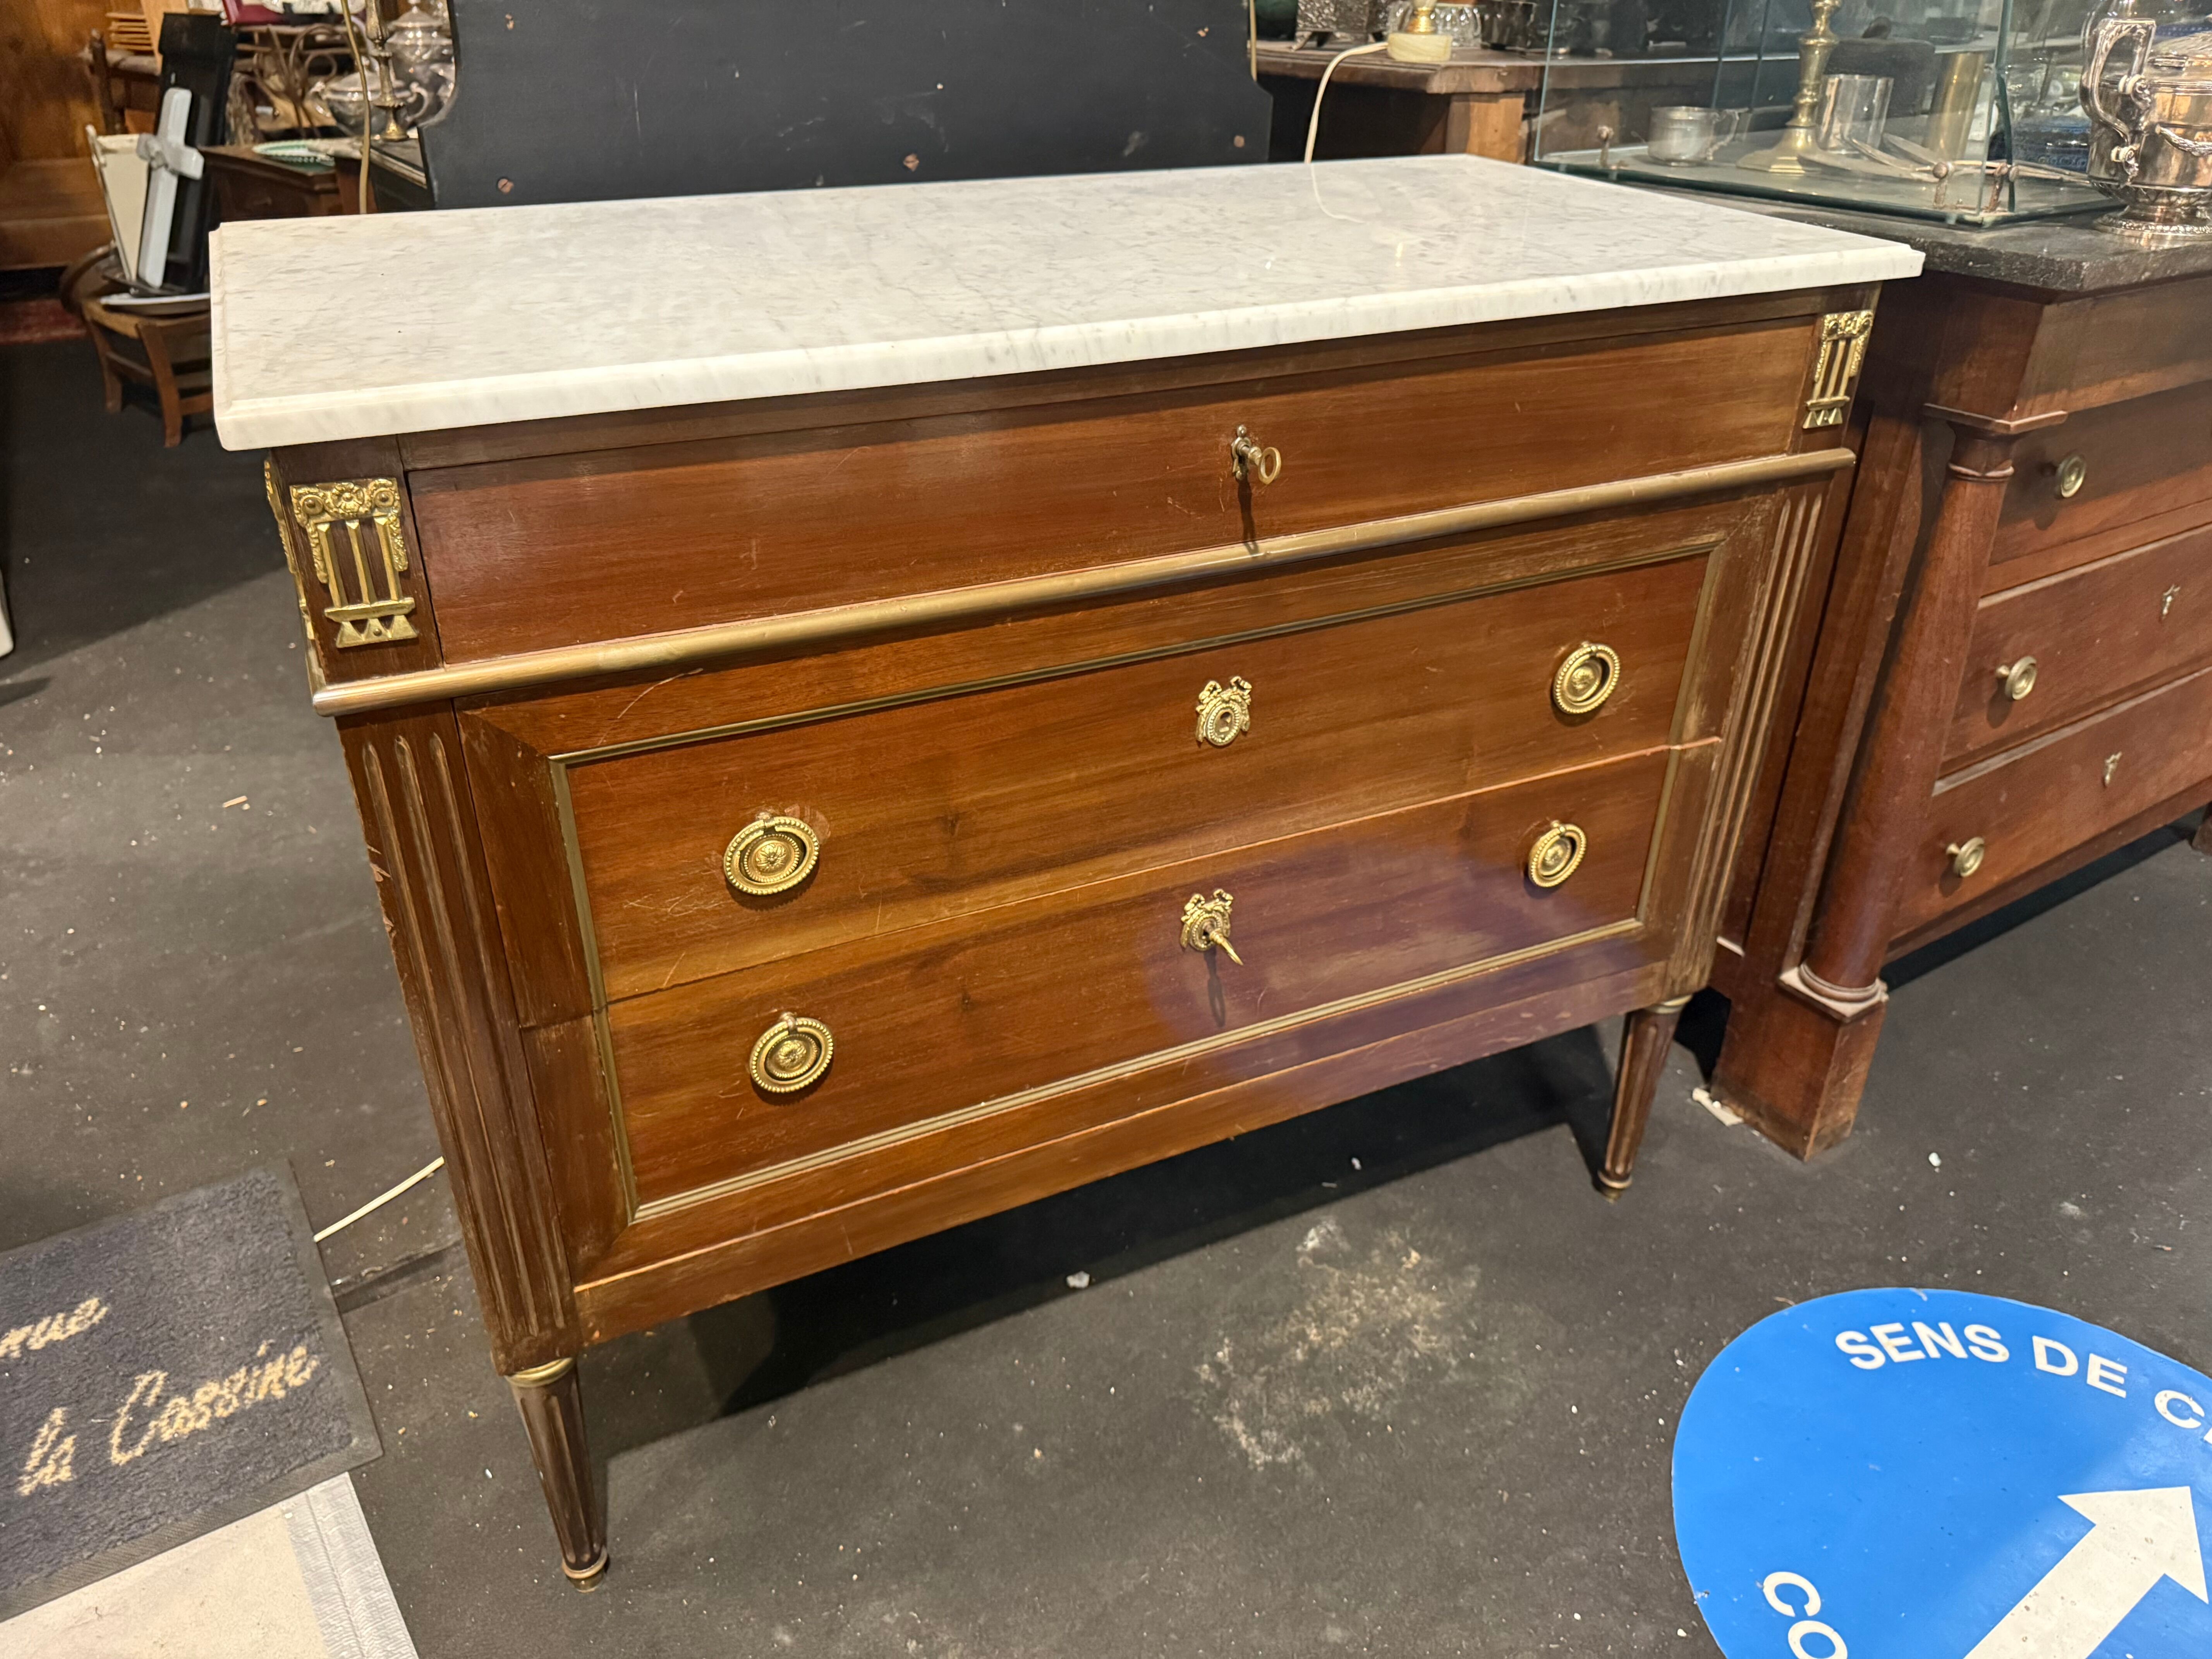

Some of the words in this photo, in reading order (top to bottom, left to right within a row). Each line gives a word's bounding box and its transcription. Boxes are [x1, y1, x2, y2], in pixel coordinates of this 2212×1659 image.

[1835, 1322, 2009, 1370] SENS
[2032, 1336, 2128, 1398] DE
[2154, 1389, 2212, 1445] C
